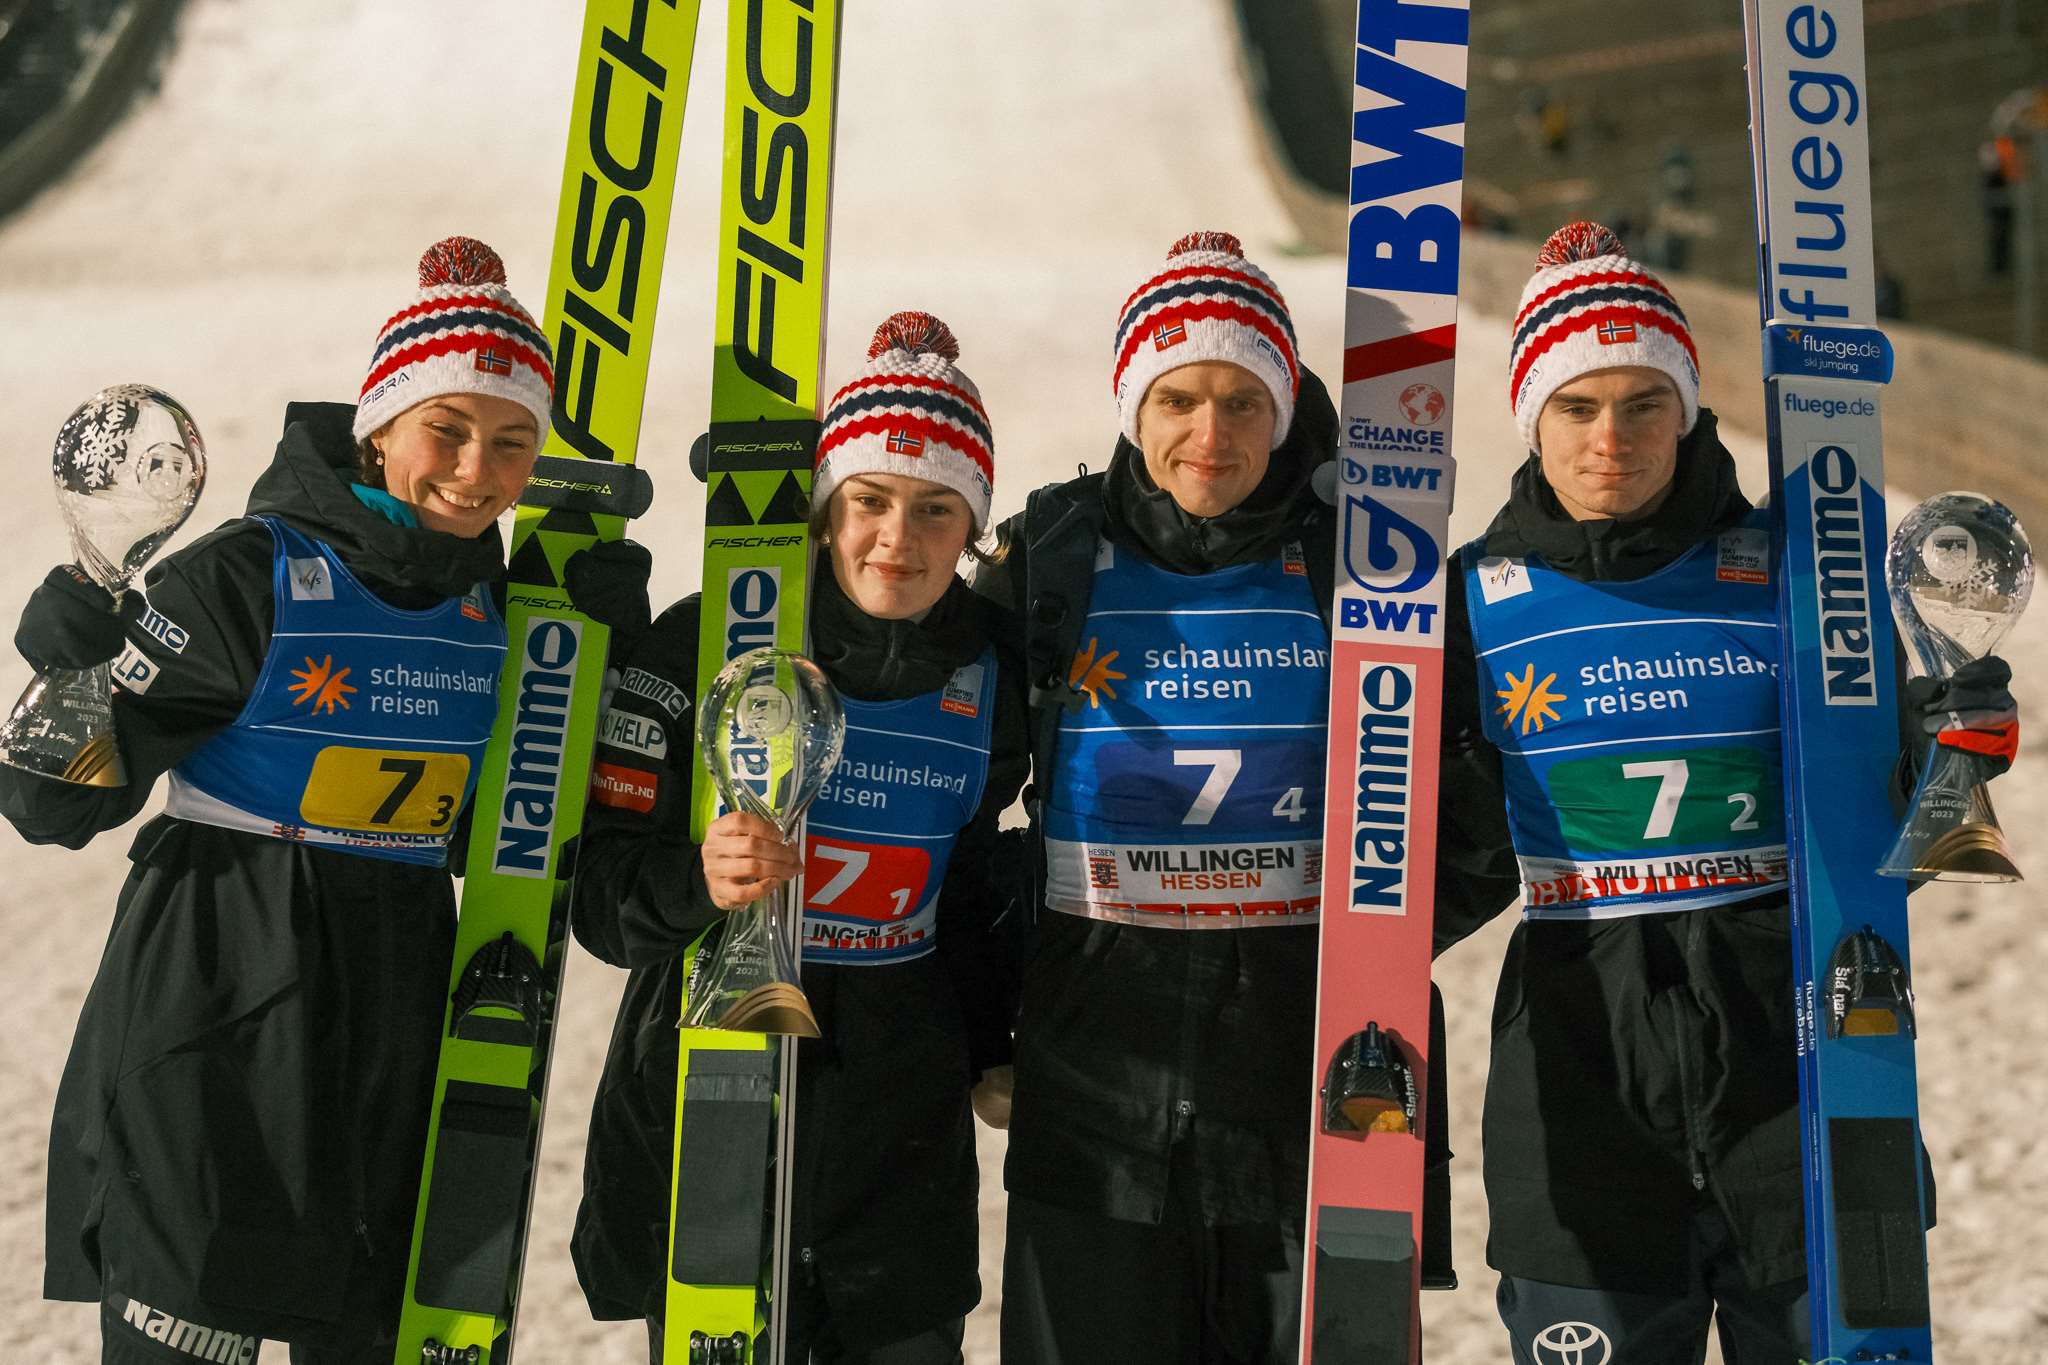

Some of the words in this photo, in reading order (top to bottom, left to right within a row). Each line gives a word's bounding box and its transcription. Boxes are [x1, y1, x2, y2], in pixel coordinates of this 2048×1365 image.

[1347, 0, 1470, 295] BWT
[733, 0, 814, 404] FISC
[1803, 334, 1880, 358] fluege.de
[1804, 357, 1818, 368] ski
[1818, 359, 1859, 374] jumping
[1784, 393, 1875, 418] fluege.de
[714, 442, 792, 454] FISCHER
[1348, 424, 1444, 447] CHANGE
[1371, 465, 1442, 491] BWT
[708, 535, 803, 549] FISCHER
[1811, 445, 1873, 701] Nammo
[1340, 598, 1438, 634] BWT
[370, 663, 493, 695] schauinsland
[1145, 673, 1252, 699] reisen
[370, 690, 440, 716] reisen
[1583, 686, 1689, 716] reisen
[496, 620, 578, 871] Nammo
[611, 715, 665, 750] HELP
[370, 758, 426, 825] 7
[430, 795, 455, 828] 3
[1174, 749, 1242, 825] 7
[1272, 787, 1308, 822] 4
[1352, 665, 1412, 908] Nammo
[1622, 759, 1690, 839] 7
[1727, 793, 1760, 831] 2
[1930, 810, 1954, 818] 2023
[1126, 847, 1296, 873] WILLINGEN
[808, 844, 870, 905] 7
[890, 888, 911, 915] 1
[1160, 872, 1262, 891] HESSEN
